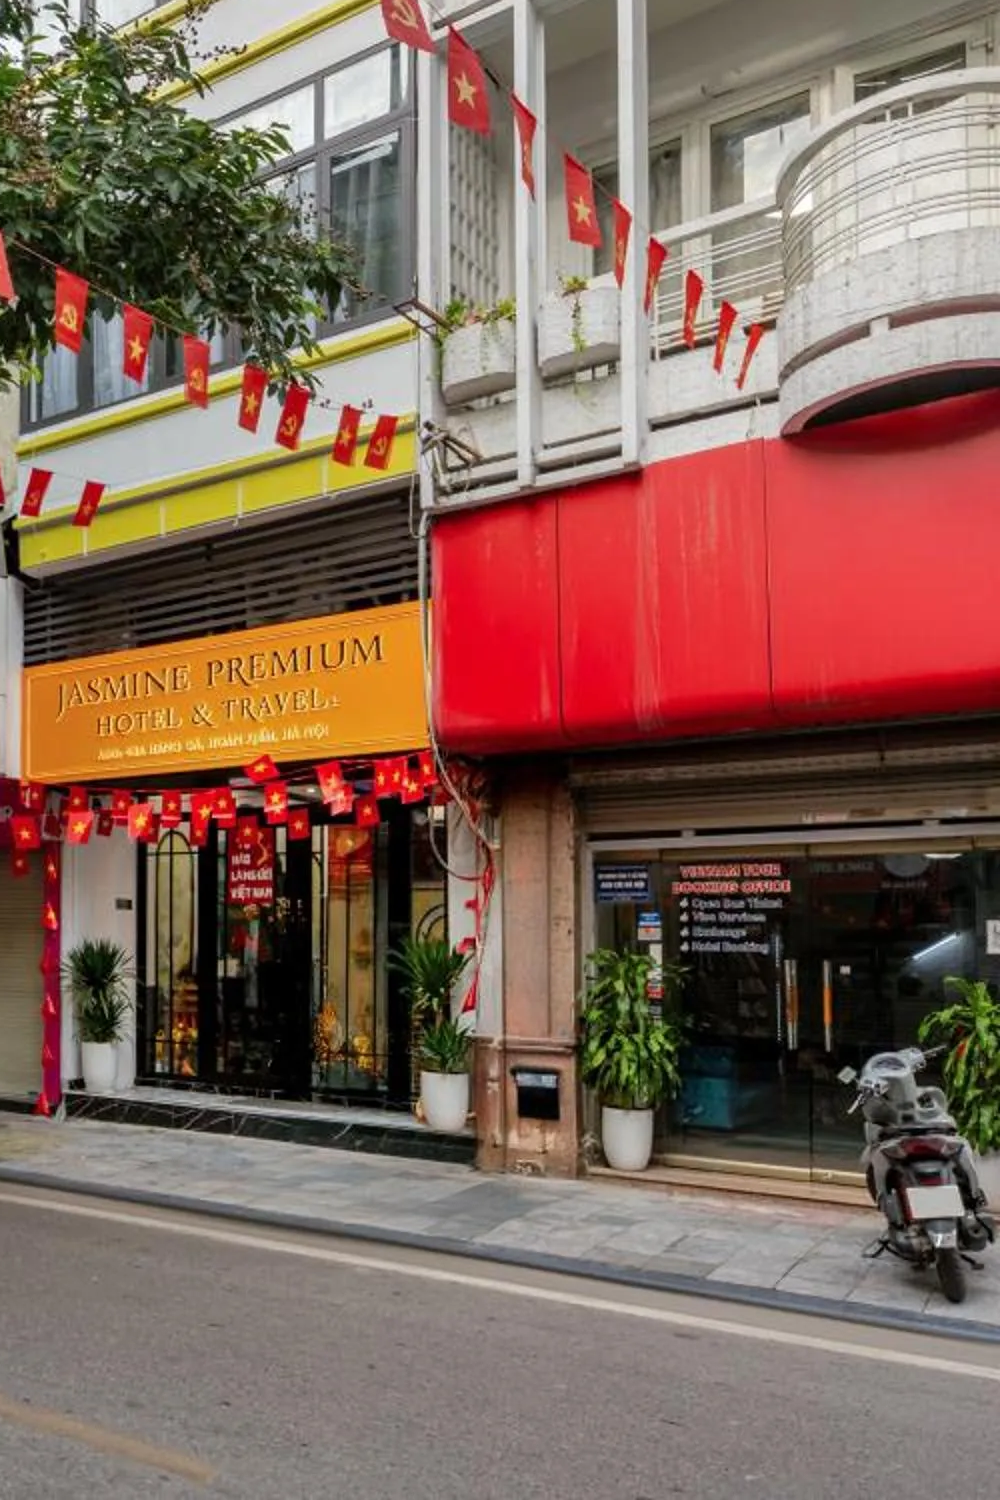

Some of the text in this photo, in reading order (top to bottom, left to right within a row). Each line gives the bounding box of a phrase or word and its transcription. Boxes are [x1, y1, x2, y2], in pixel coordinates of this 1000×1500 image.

[56, 634, 385, 722] JASMINE PREMIUM
[96, 706, 182, 738] HOTEL
[192, 703, 217, 729] &
[220, 688, 328, 721] TRAVEL
